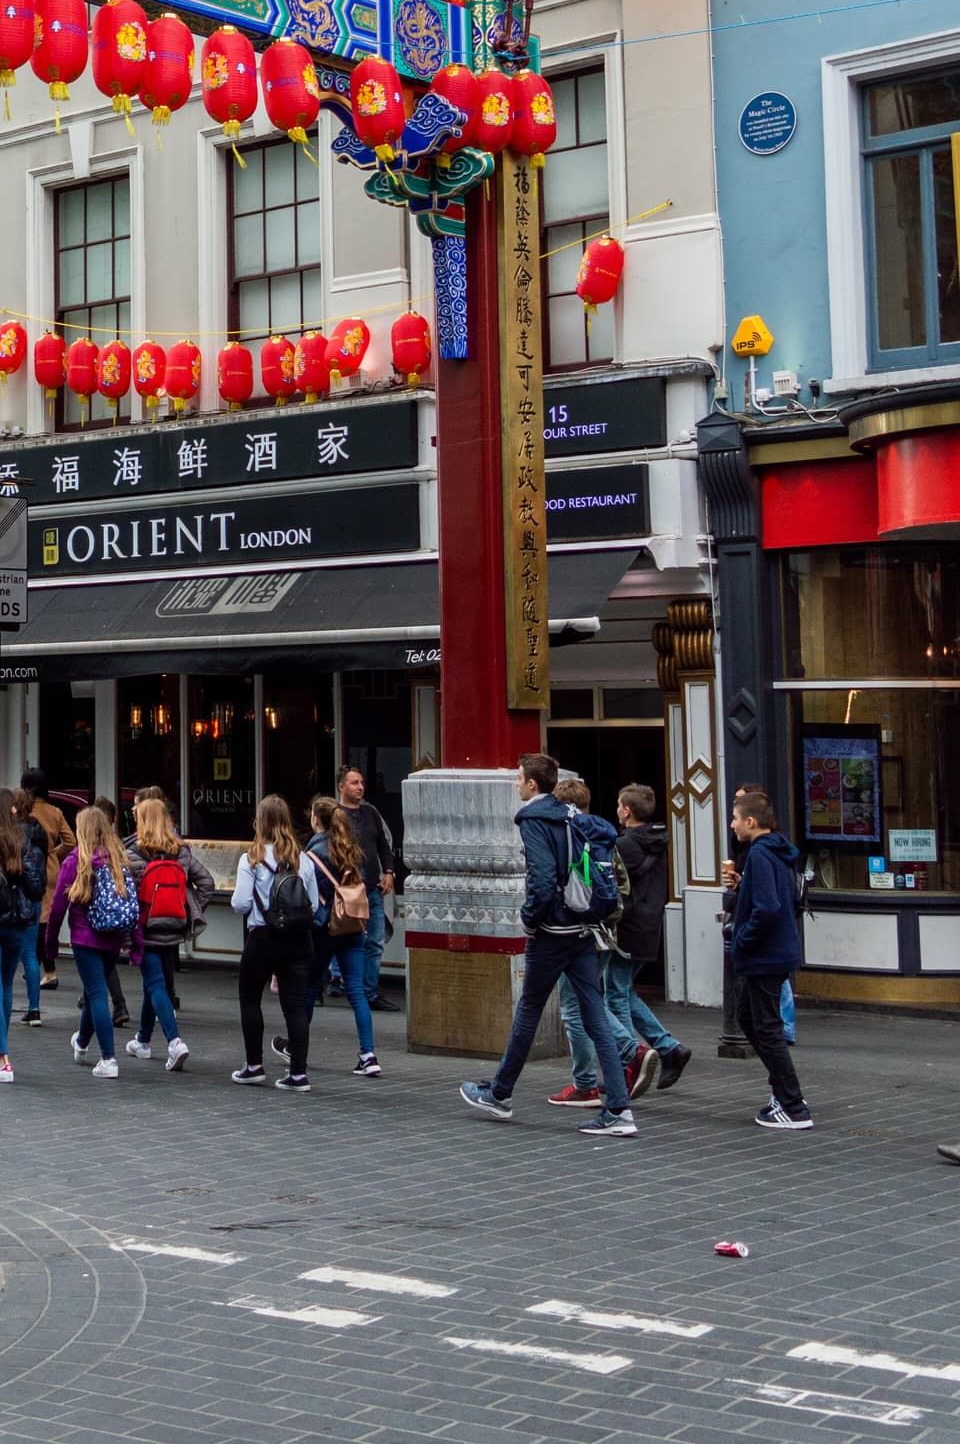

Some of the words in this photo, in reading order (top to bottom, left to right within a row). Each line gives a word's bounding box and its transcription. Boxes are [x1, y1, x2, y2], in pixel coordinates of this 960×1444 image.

[737, 340, 755, 350] IPS
[548, 405, 568, 423] 15
[570, 423, 608, 437] STREET
[568, 493, 638, 509] RESTAURANT
[67, 512, 236, 563] ORIENT
[240, 528, 312, 549] LONDON
[405, 649, 425, 663] Tel:
[193, 788, 254, 805] ORIENT
[894, 837, 909, 847] NOW
[912, 837, 931, 847] HIRING
